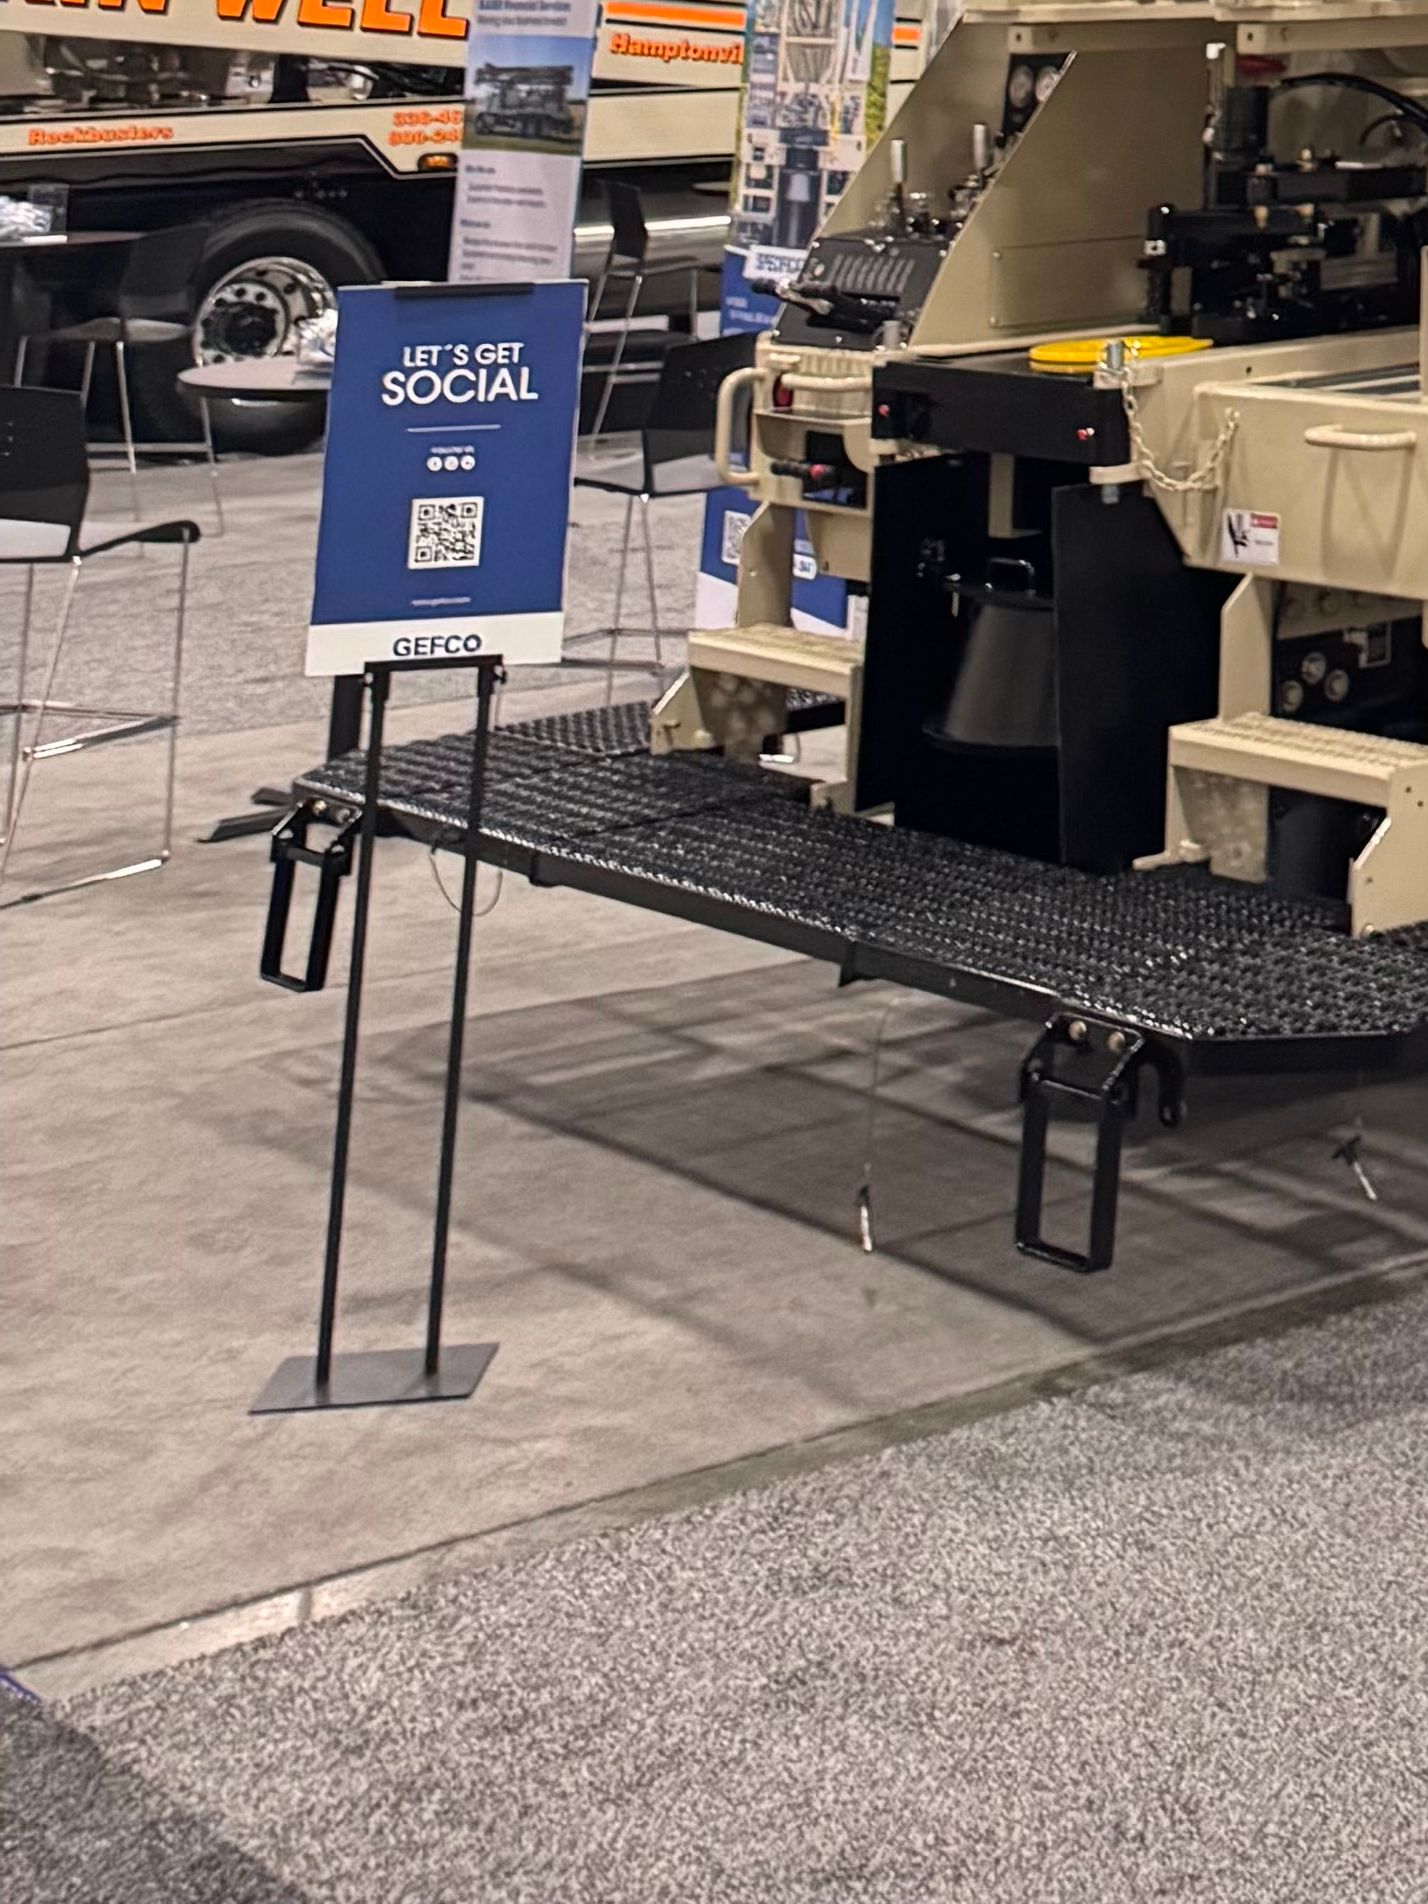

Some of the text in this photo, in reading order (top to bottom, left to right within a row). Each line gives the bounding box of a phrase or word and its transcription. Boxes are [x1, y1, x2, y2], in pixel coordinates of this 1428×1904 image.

[474, 342, 525, 365] GET
[381, 366, 540, 406] SOCIAL
[392, 634, 483, 657] GEFCO
